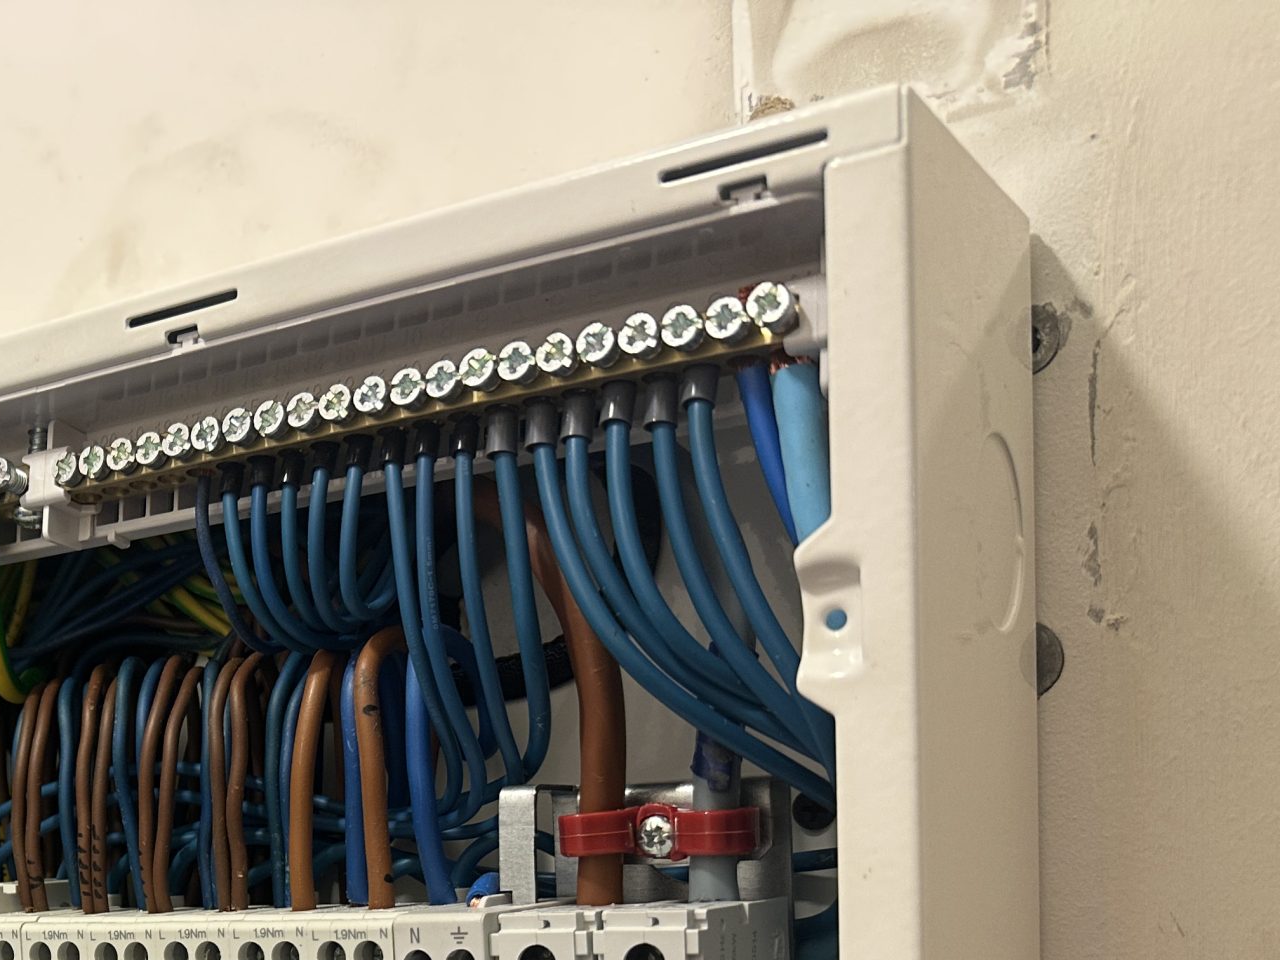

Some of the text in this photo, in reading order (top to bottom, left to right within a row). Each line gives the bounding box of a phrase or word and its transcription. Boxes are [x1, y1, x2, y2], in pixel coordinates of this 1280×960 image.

[12, 930, 18, 939] N
[77, 930, 84, 940] N
[145, 930, 152, 940] N
[217, 928, 224, 938] N
[296, 927, 304, 937] N
[380, 928, 388, 938] N
[410, 928, 420, 944] N
